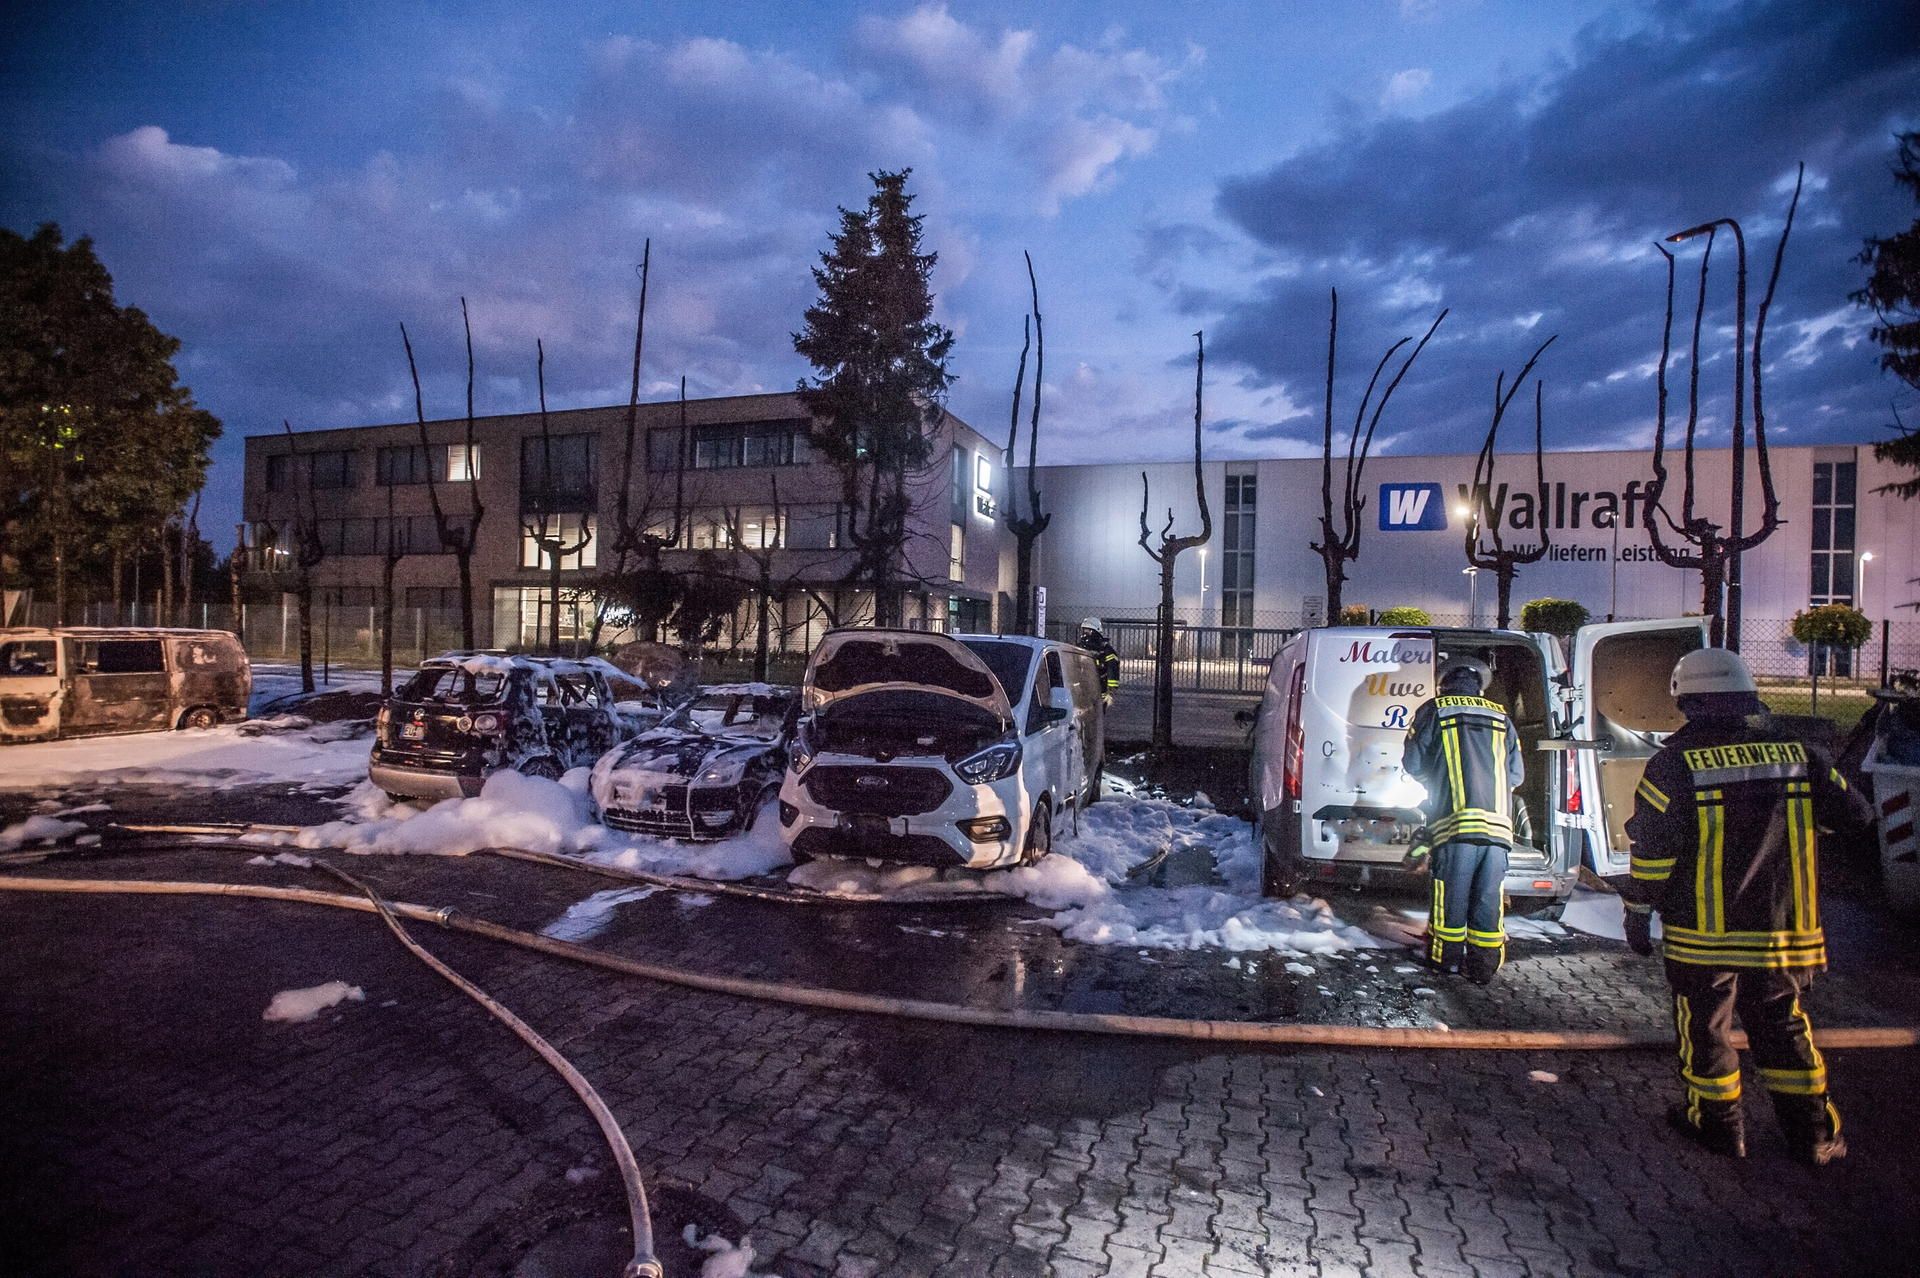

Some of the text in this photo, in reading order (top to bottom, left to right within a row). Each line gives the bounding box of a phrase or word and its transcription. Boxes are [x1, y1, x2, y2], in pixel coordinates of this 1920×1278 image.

[1390, 490, 1430, 525] W
[1458, 480, 1660, 530] Wallraff
[1513, 544, 1543, 561] Wi
[1549, 544, 1607, 562] liefern
[1366, 673, 1426, 697] Uwe
[1381, 704, 1415, 728] R
[1438, 696, 1504, 713] FEUERWEHR
[1687, 743, 1805, 770] FEUERWEHR
